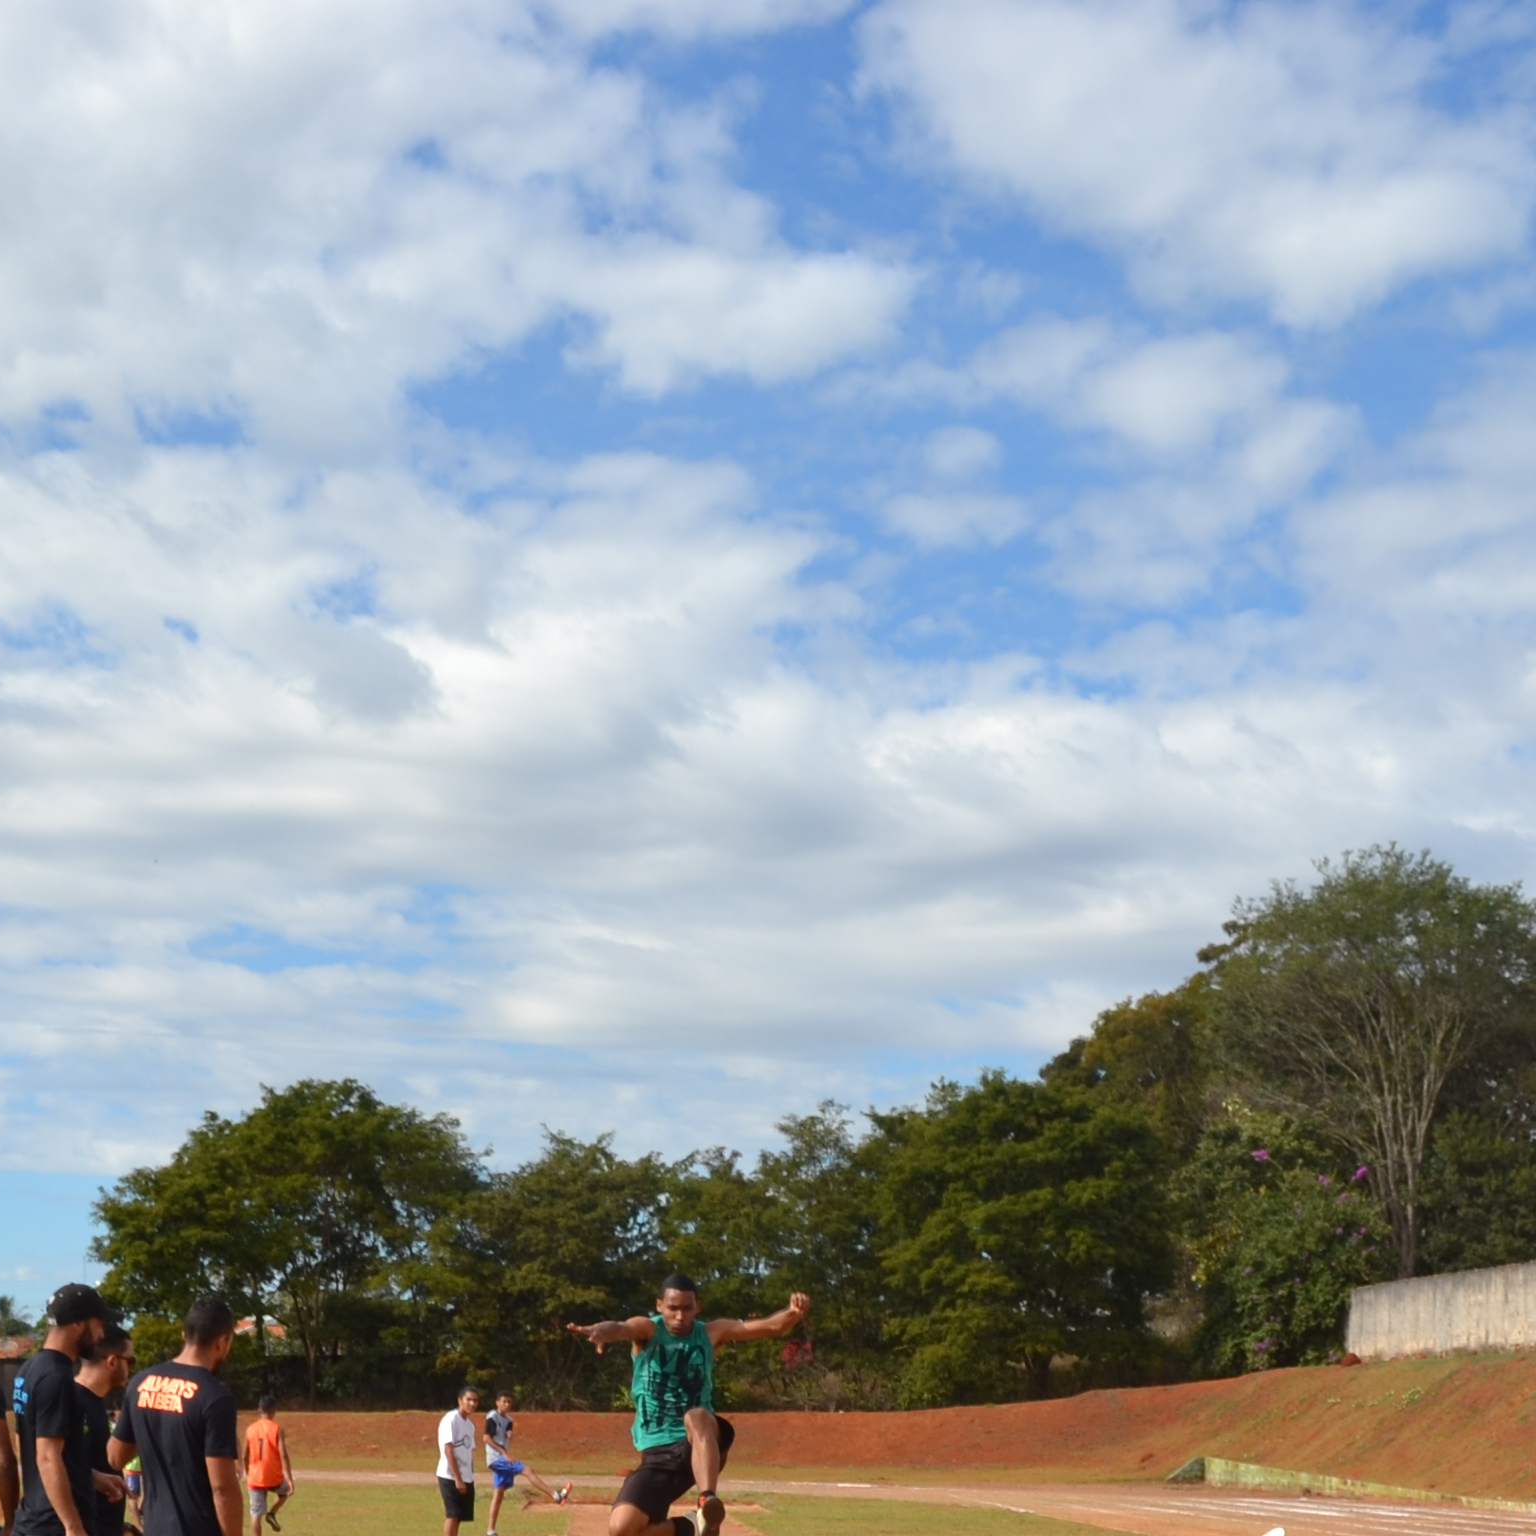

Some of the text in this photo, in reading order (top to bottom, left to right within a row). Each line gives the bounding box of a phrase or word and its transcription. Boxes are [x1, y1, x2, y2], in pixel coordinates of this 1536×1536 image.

[137, 1374, 199, 1399] ALWAYS
[137, 1391, 183, 1413] IN BETA
